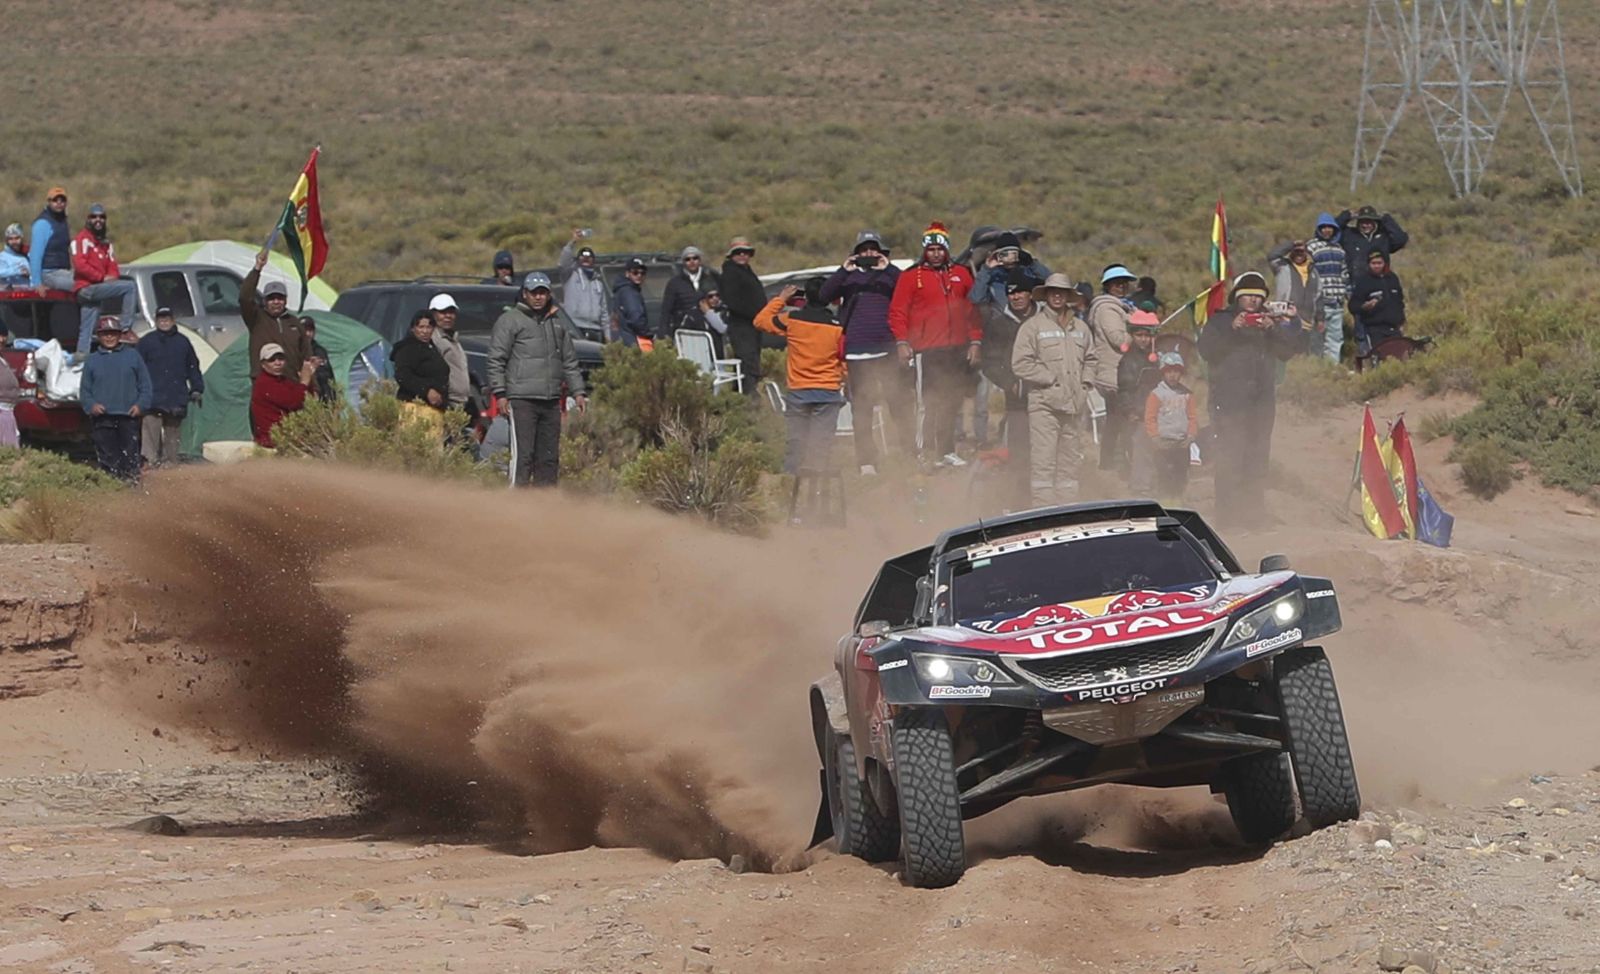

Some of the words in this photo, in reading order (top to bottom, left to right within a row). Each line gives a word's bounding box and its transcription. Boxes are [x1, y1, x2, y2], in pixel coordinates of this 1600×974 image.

[1016, 611, 1204, 649] TOTAL
[1248, 628, 1301, 653] BFGoodrich
[931, 686, 990, 695] BFGoodrich
[1079, 678, 1168, 700] PEUGEOT
